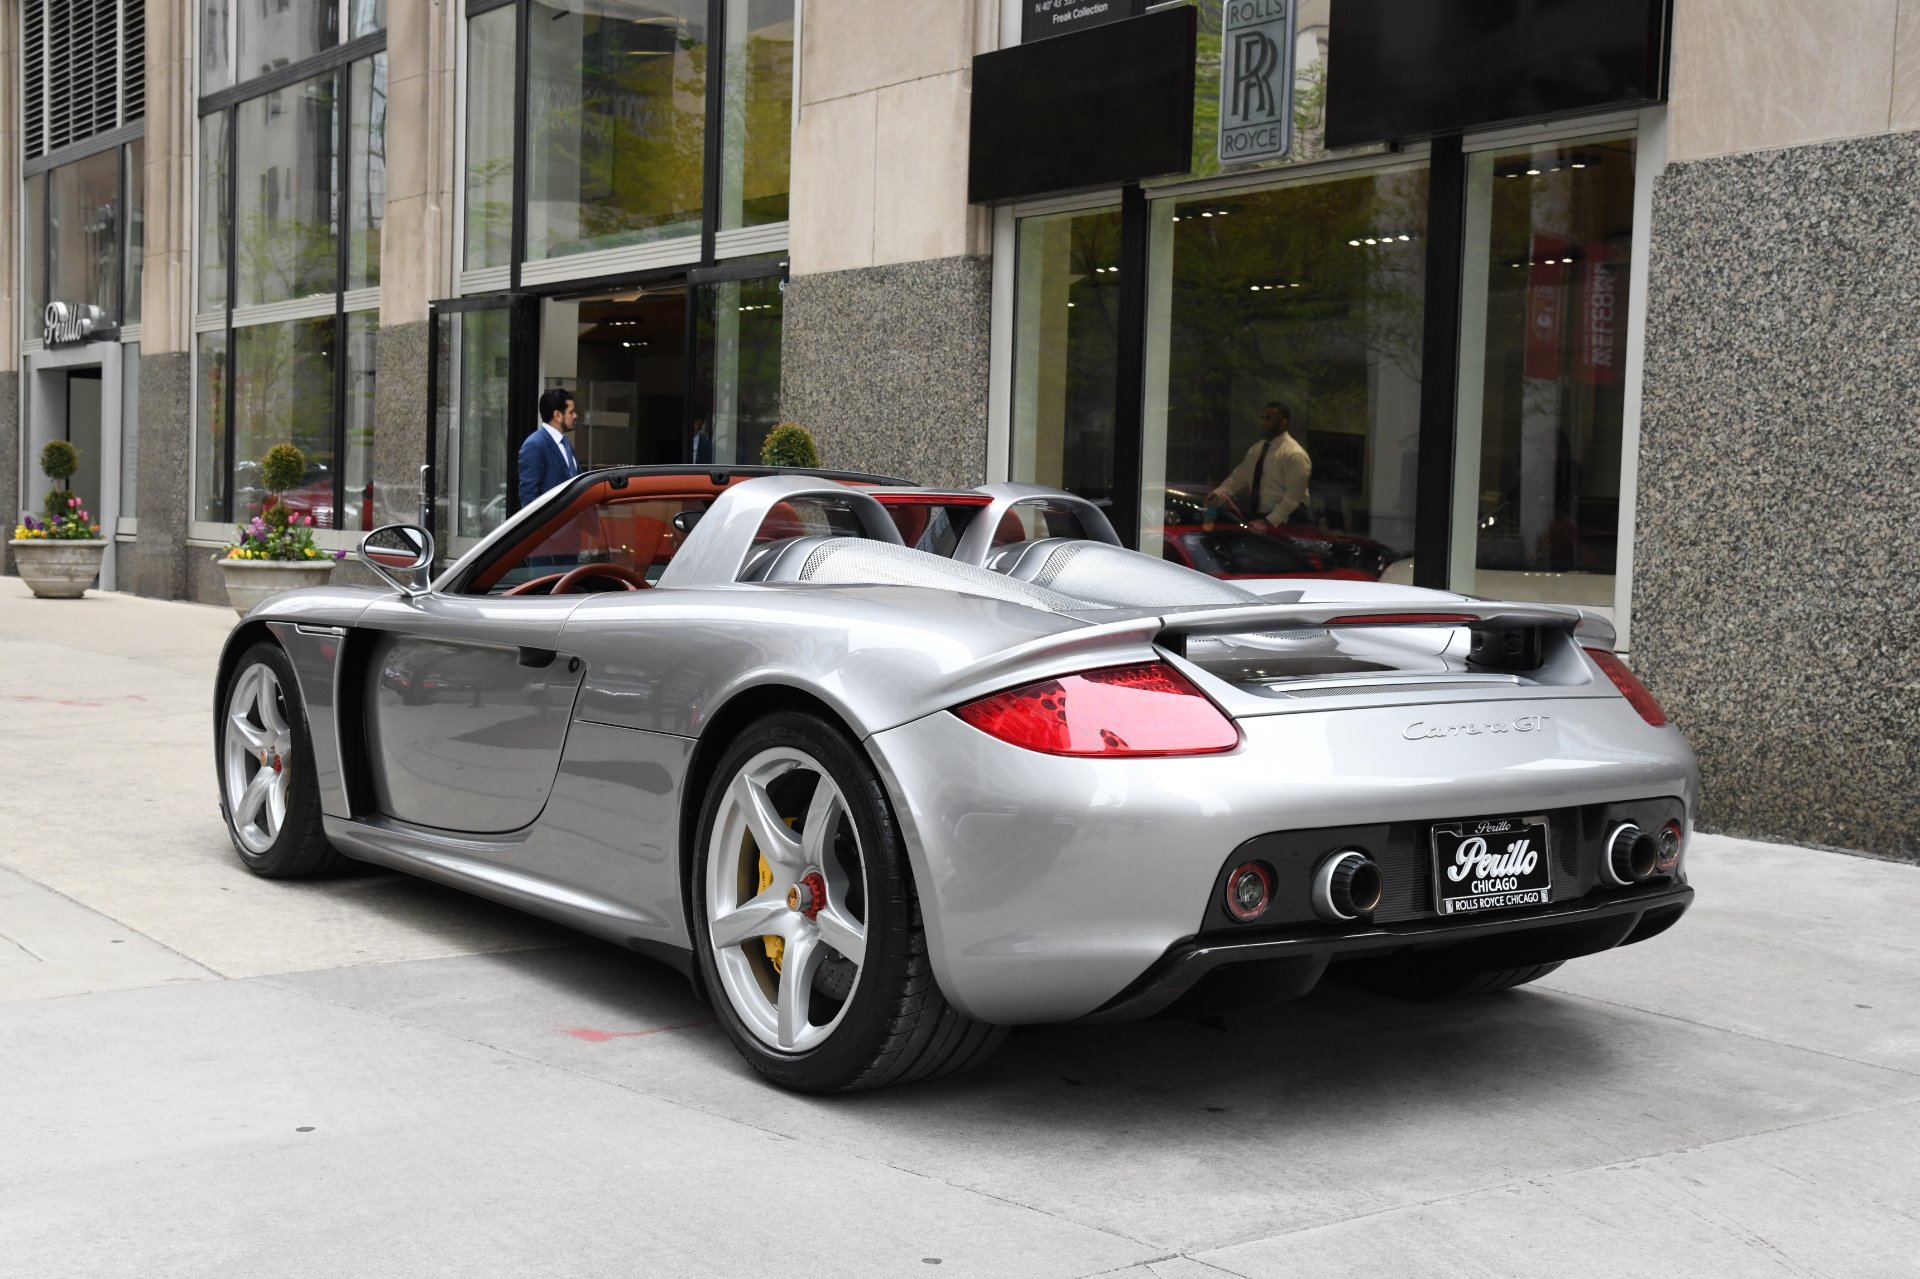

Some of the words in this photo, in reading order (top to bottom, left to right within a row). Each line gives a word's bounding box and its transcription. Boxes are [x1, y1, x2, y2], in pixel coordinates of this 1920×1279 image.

[1035, 3, 1041, 13] N
[1052, 10, 1072, 24] Freak
[1073, 2, 1108, 19] Collection
[1230, 0, 1283, 24] ROLLS
[1225, 127, 1278, 153] ROYCE
[44, 302, 82, 344] Perillo
[1402, 721, 1509, 741] Carrera
[1512, 715, 1550, 732] GT
[1474, 821, 1511, 834] Perillo
[1447, 837, 1538, 882] Perillo
[1471, 877, 1518, 893] CHICAGO
[1455, 899, 1478, 911] ROLLS
[1479, 895, 1505, 908] ROYCE
[1506, 892, 1539, 905] CHICAGO
